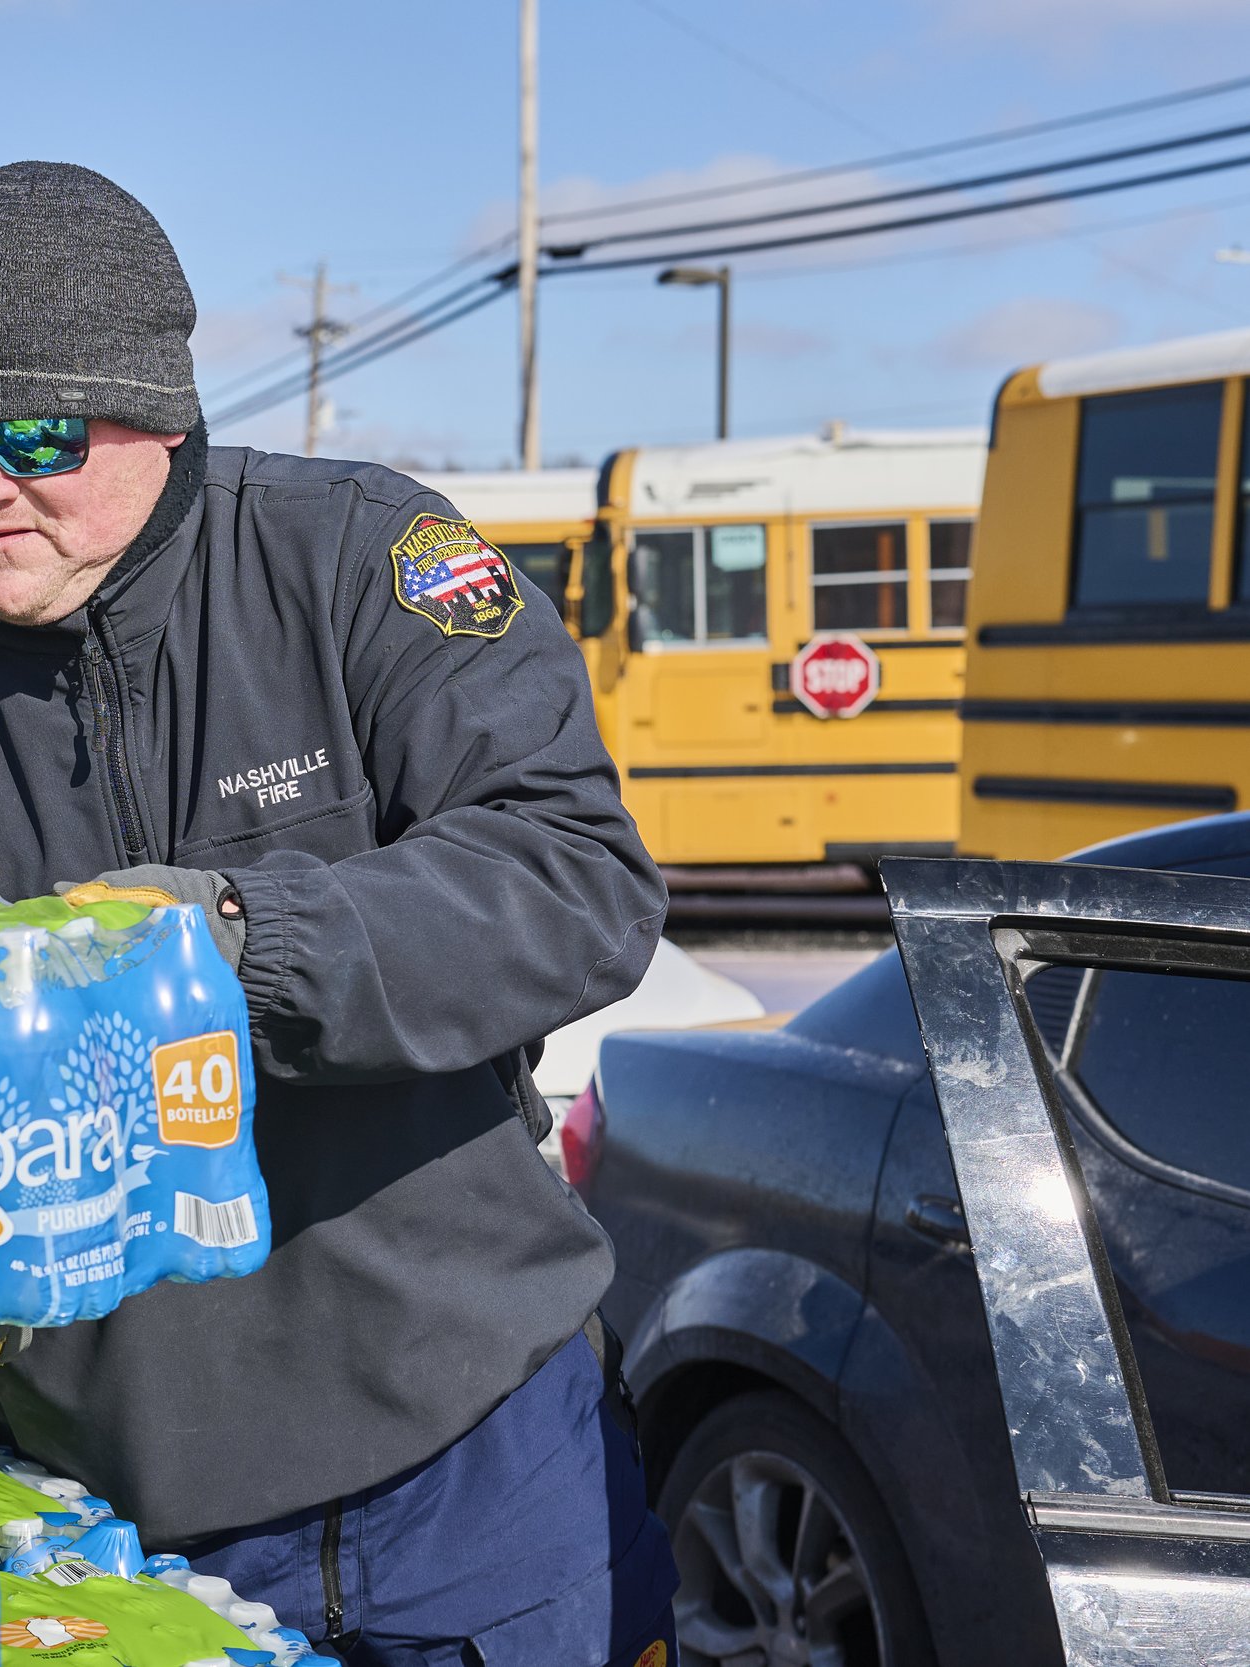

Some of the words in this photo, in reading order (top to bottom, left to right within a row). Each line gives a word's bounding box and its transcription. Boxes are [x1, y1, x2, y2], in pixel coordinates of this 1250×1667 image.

[402, 523, 475, 562] NASHVILLE
[415, 554, 436, 575] FIRE
[433, 543, 484, 563] DEPARTMENT
[473, 599, 492, 610] est.
[473, 605, 501, 623] 1860
[805, 658, 868, 694] STOP
[217, 748, 330, 798] NASHVILLE
[256, 779, 302, 808] FIRE
[162, 1053, 234, 1104] 40
[166, 1105, 235, 1124] BOTELLAS
